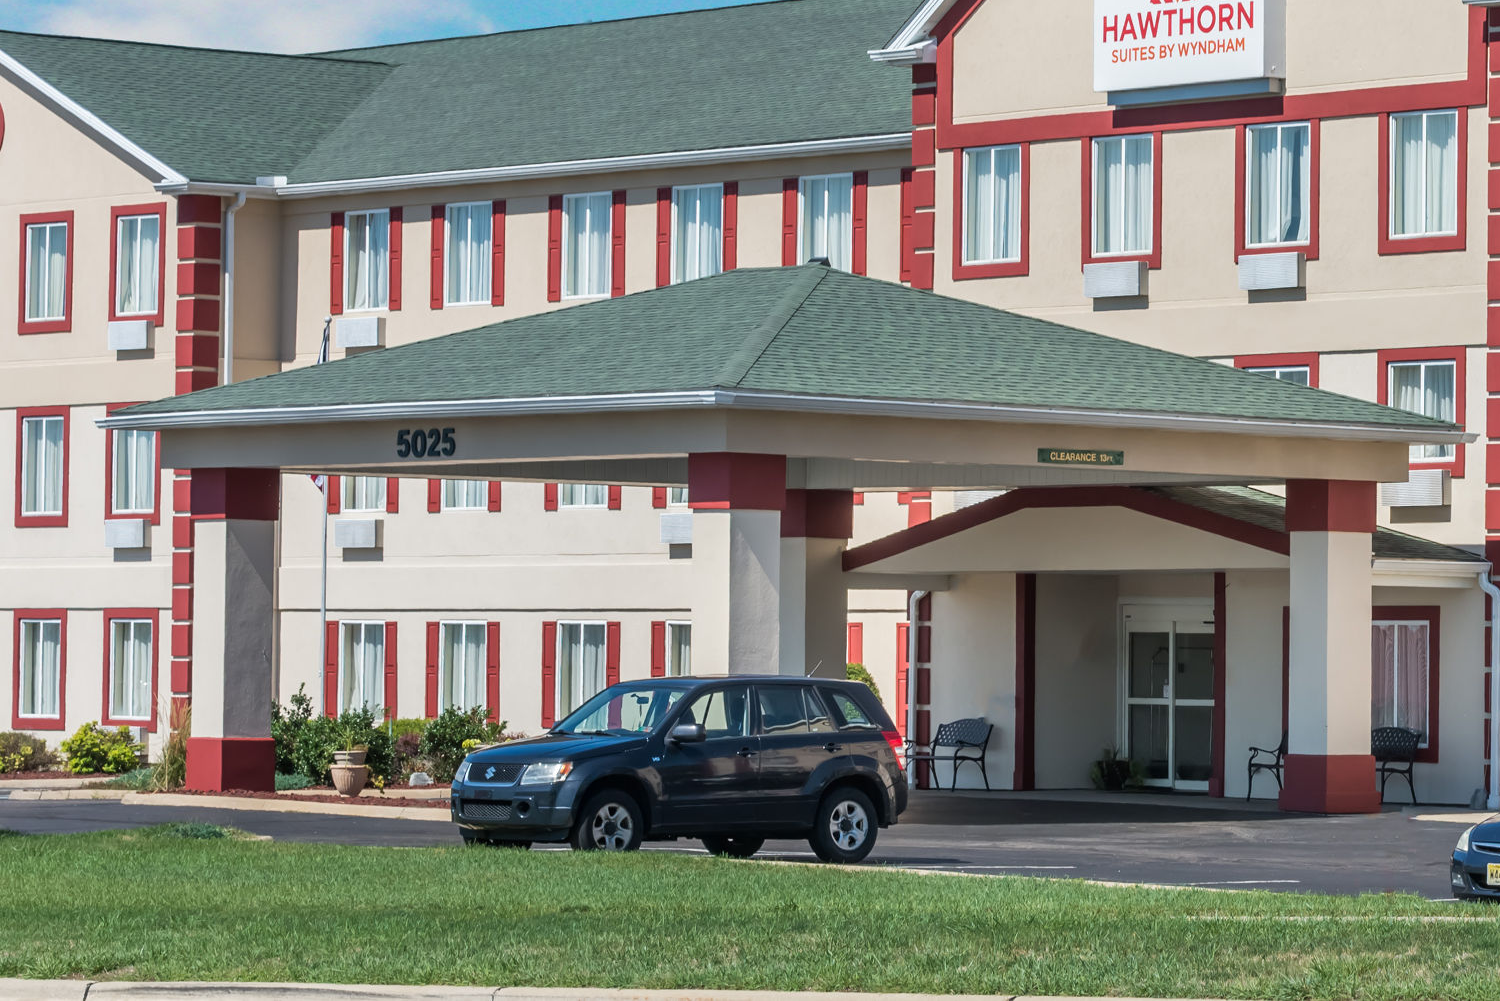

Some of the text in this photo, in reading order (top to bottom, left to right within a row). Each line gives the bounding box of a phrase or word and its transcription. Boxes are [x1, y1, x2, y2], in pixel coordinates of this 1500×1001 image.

[1103, 1, 1254, 43] HAWTHORN
[1111, 37, 1245, 63] SUITES BY WYNDHAM
[397, 427, 456, 458] 5025
[1050, 451, 1097, 462] CLEARANCE
